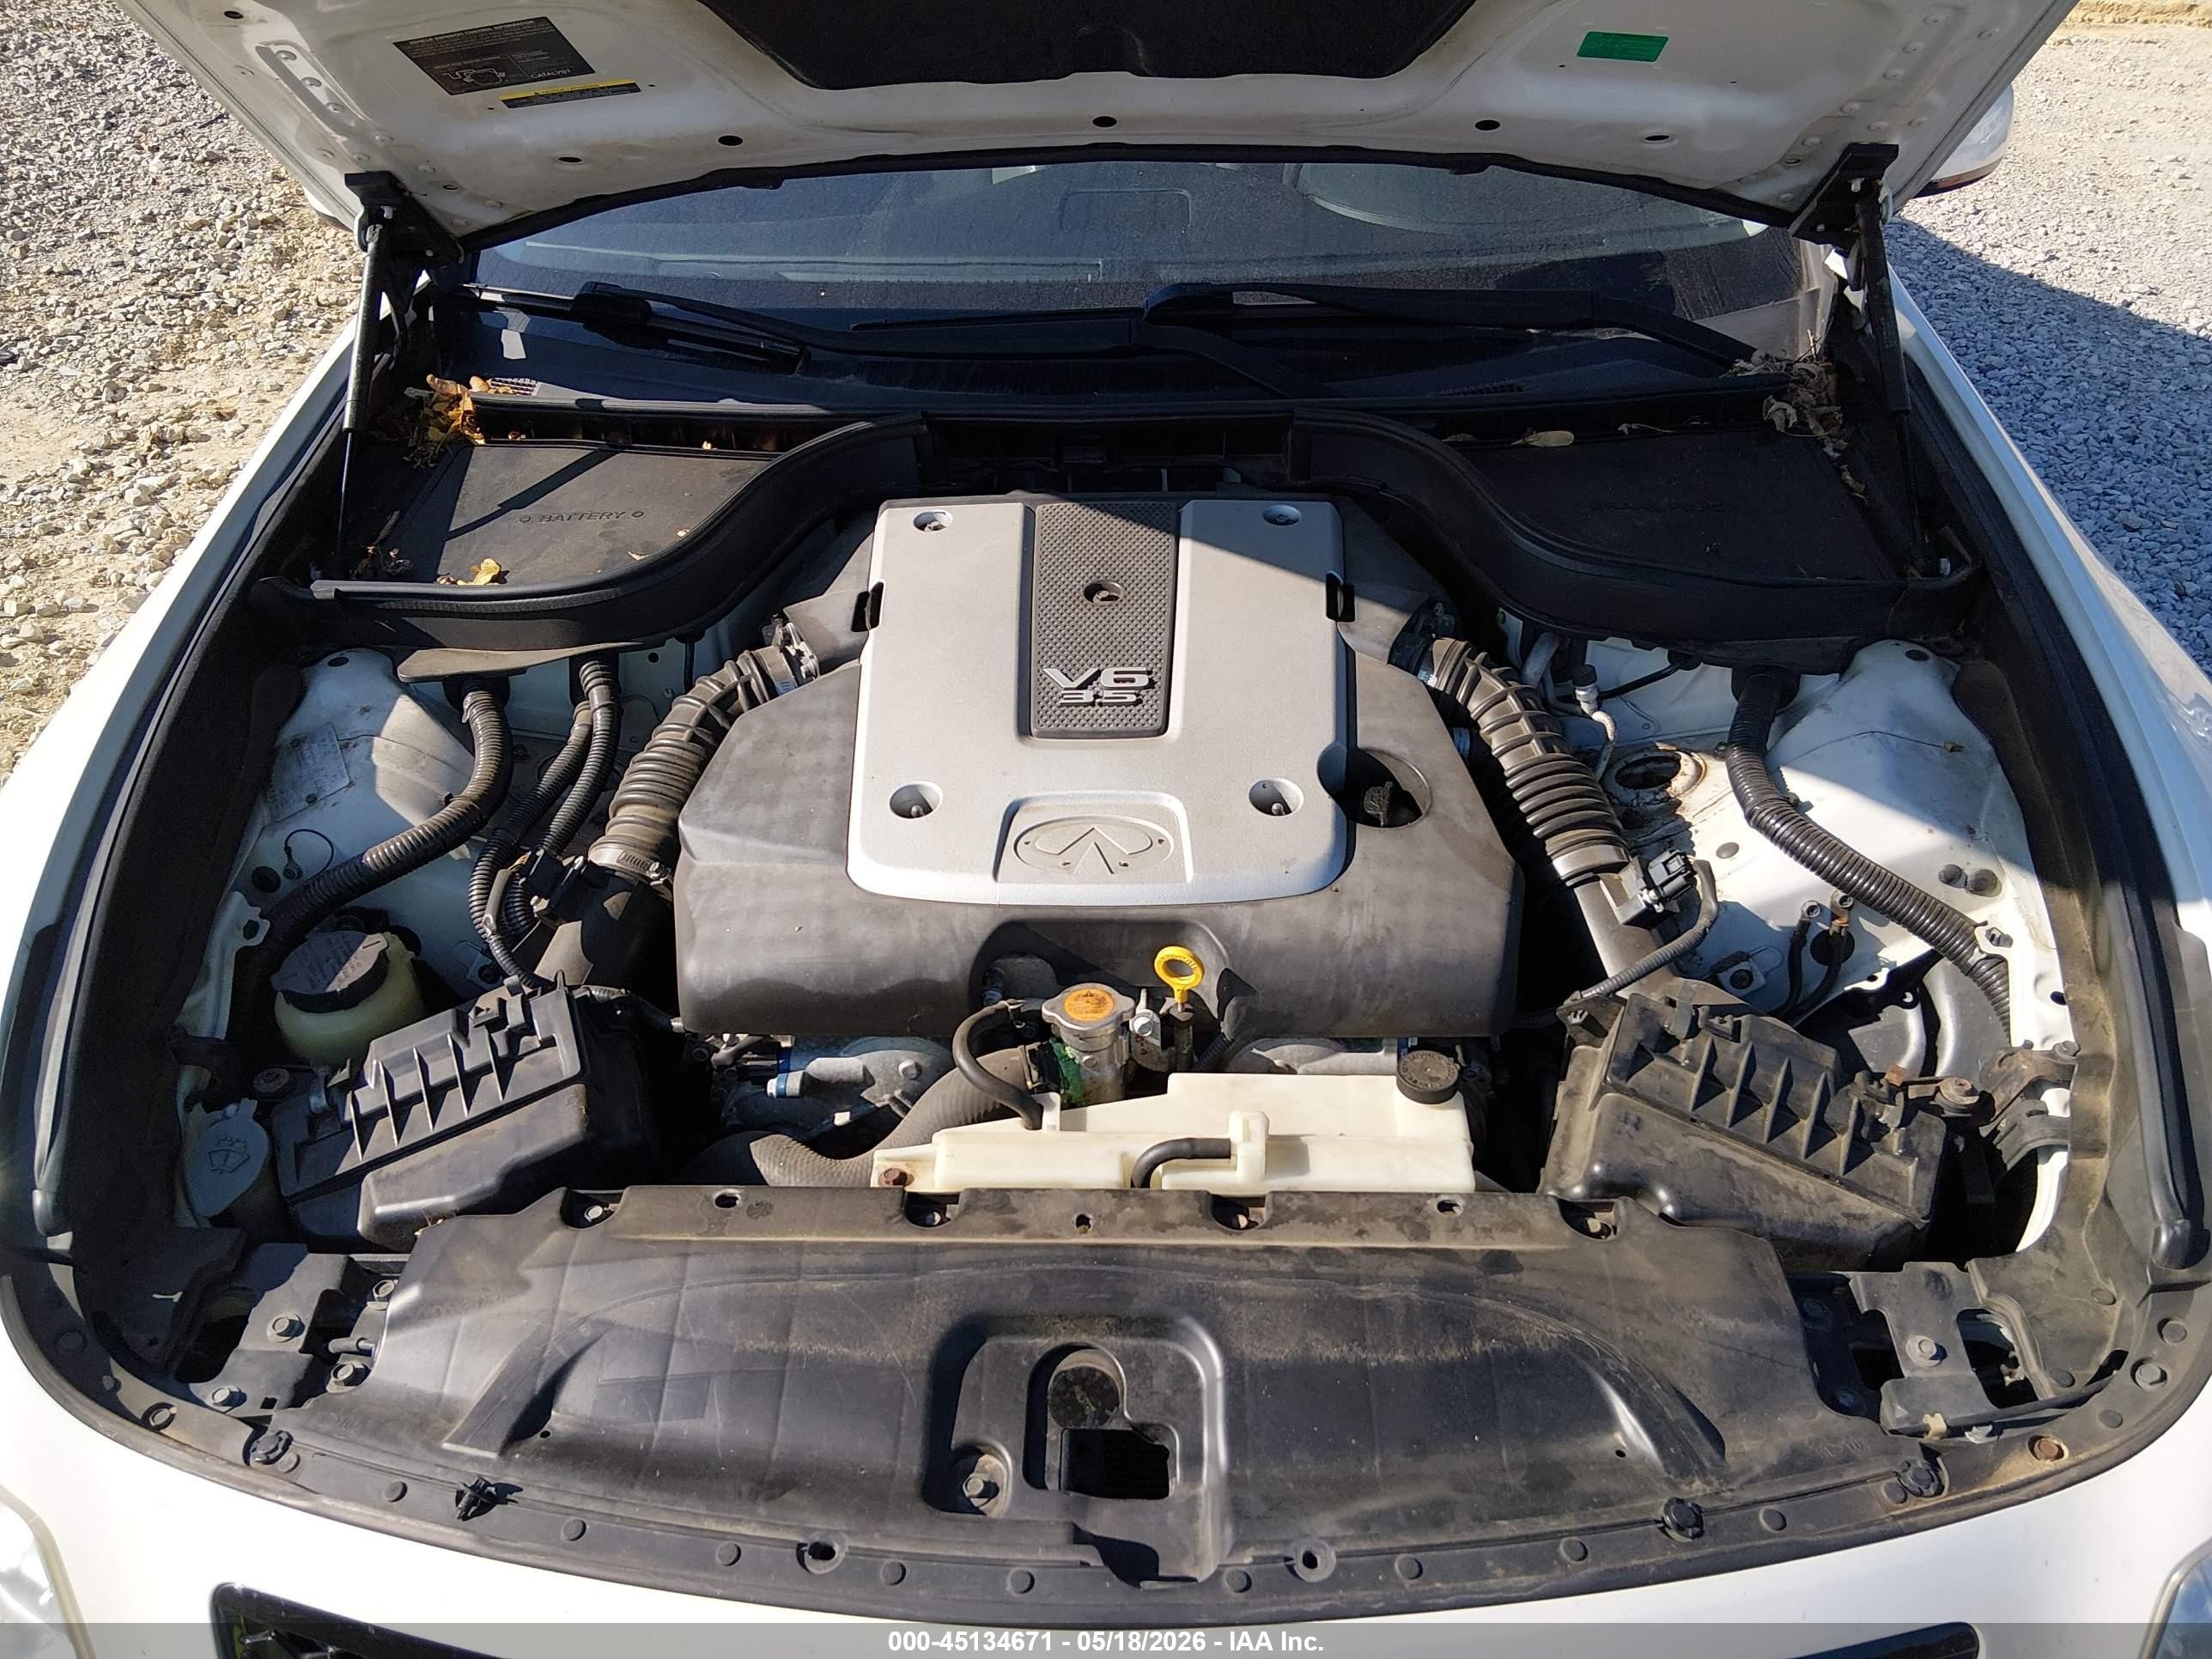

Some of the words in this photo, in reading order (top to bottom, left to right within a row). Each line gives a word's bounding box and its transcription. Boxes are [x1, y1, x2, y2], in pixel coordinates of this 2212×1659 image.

[530, 68, 571, 79] CATALYST
[539, 510, 626, 524] BATTERY
[1042, 666, 1151, 689] V6
